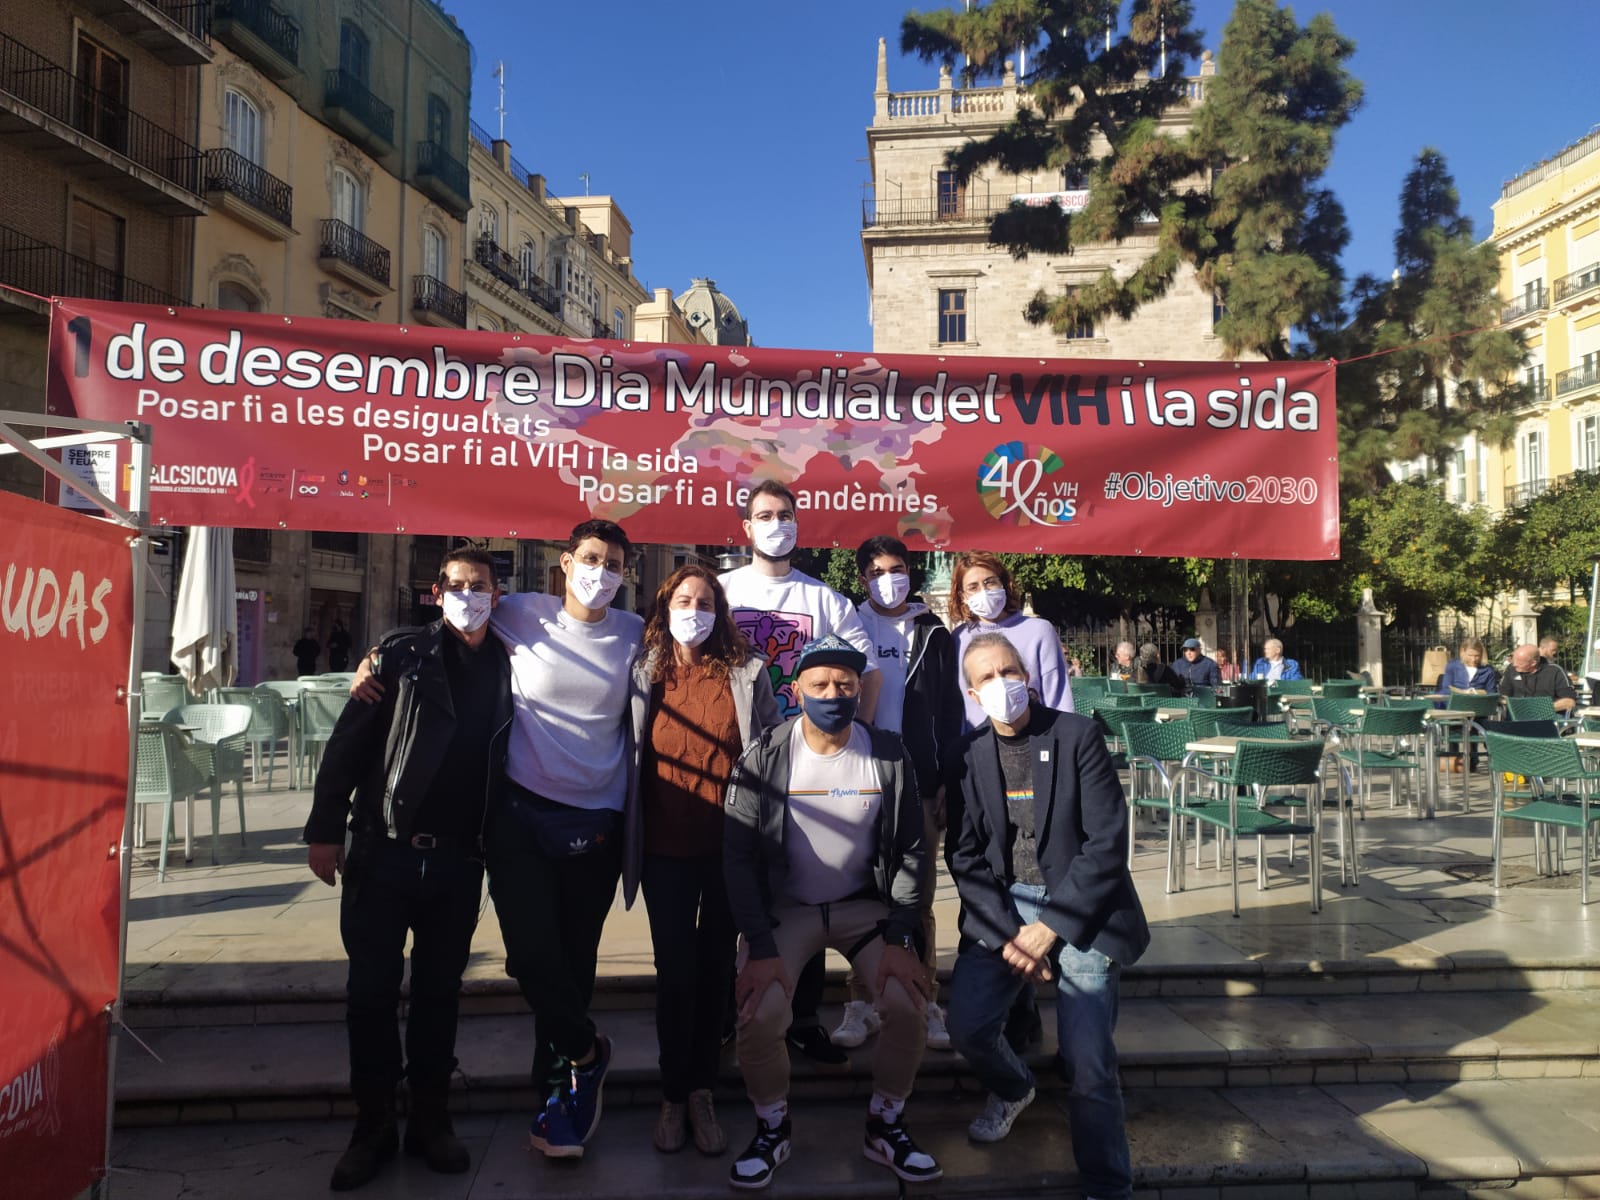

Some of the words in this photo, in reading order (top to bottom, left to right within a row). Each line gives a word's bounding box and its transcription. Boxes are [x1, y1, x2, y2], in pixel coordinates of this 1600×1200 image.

[67, 316, 92, 378] 1
[106, 323, 185, 382] de
[200, 329, 540, 405] desembre
[553, 353, 650, 411] Dia
[664, 360, 901, 422] Mundial
[911, 371, 1002, 424] del
[1009, 373, 1110, 426] VIH
[1121, 376, 1136, 426] i
[1144, 376, 1197, 428] la
[1207, 377, 1320, 432] sida
[137, 389, 235, 423] Posar
[243, 395, 262, 423] fi
[271, 403, 288, 424] a
[297, 396, 345, 427] les
[352, 401, 550, 437] desigualtats
[69, 449, 111, 459] SEMPRE
[69, 457, 98, 466] TEUA
[363, 433, 456, 466] Posar
[463, 439, 482, 466] fi
[490, 439, 518, 468] al
[526, 442, 579, 469] VIH
[587, 448, 594, 470] i
[602, 448, 628, 472] la
[636, 449, 698, 474] sida
[150, 464, 238, 487] ALCSICOVA
[1053, 482, 1079, 497] VIH
[1104, 472, 1318, 507] #Objetivo2030
[578, 475, 672, 505] Posar
[676, 478, 694, 506] fi
[702, 485, 717, 506] a
[726, 479, 749, 506] le
[797, 481, 938, 513] andèmies
[0, 563, 112, 650] UDAS
